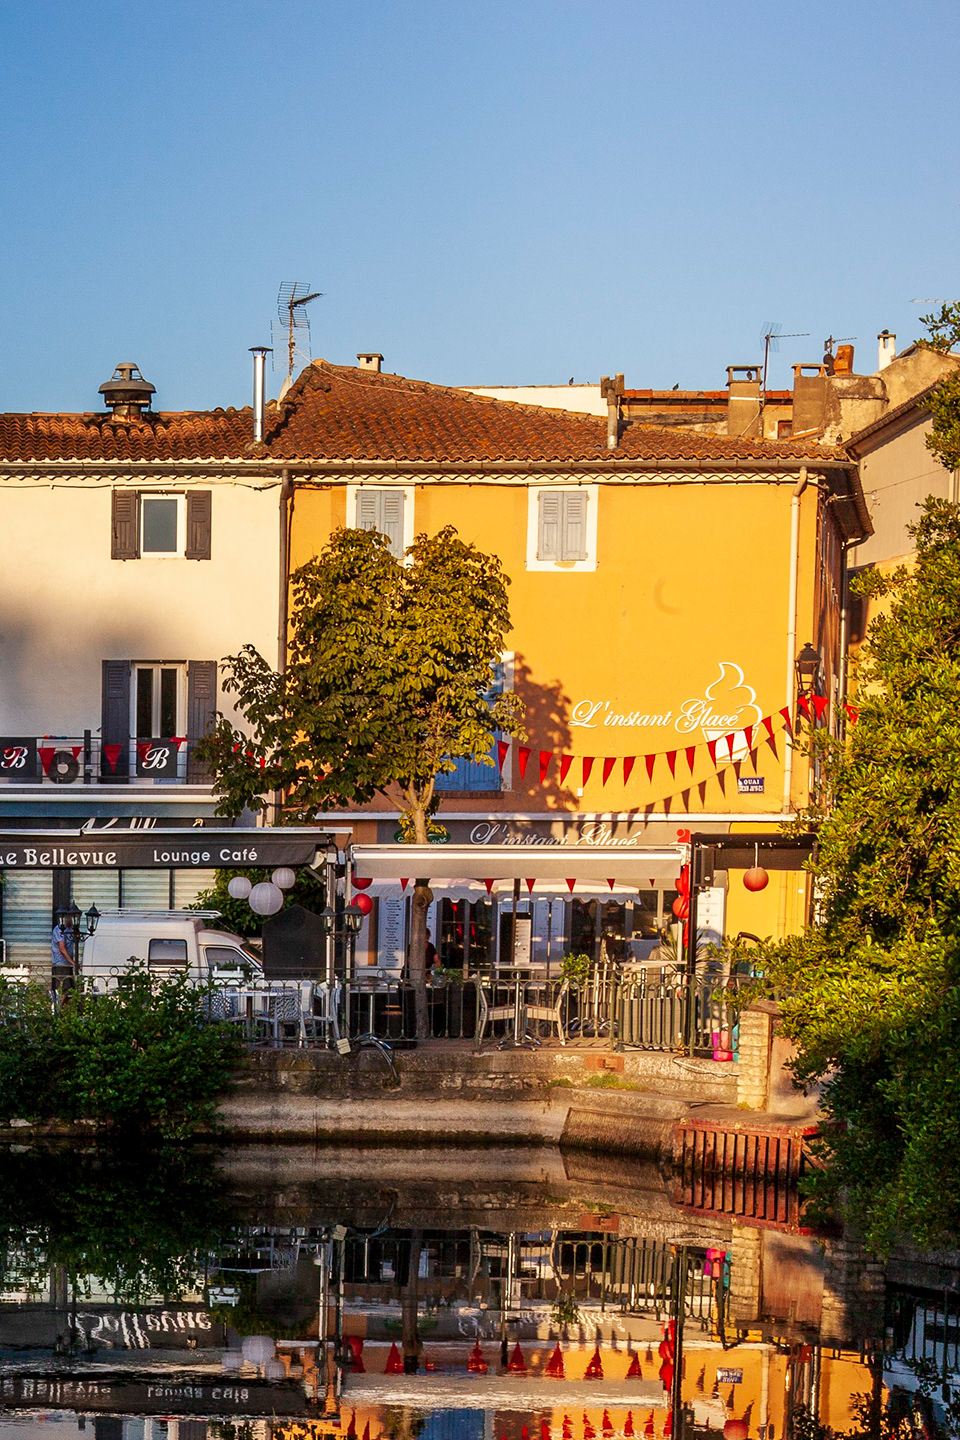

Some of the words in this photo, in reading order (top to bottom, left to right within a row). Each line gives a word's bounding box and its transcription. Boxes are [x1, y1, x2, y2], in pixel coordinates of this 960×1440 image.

[568, 700, 672, 728] L'instant
[674, 698, 744, 734] Glacé
[0, 746, 29, 769] B
[142, 747, 170, 770] B
[23, 848, 117, 866] Bellevue
[153, 849, 211, 865] Lounge
[219, 847, 258, 862] Café
